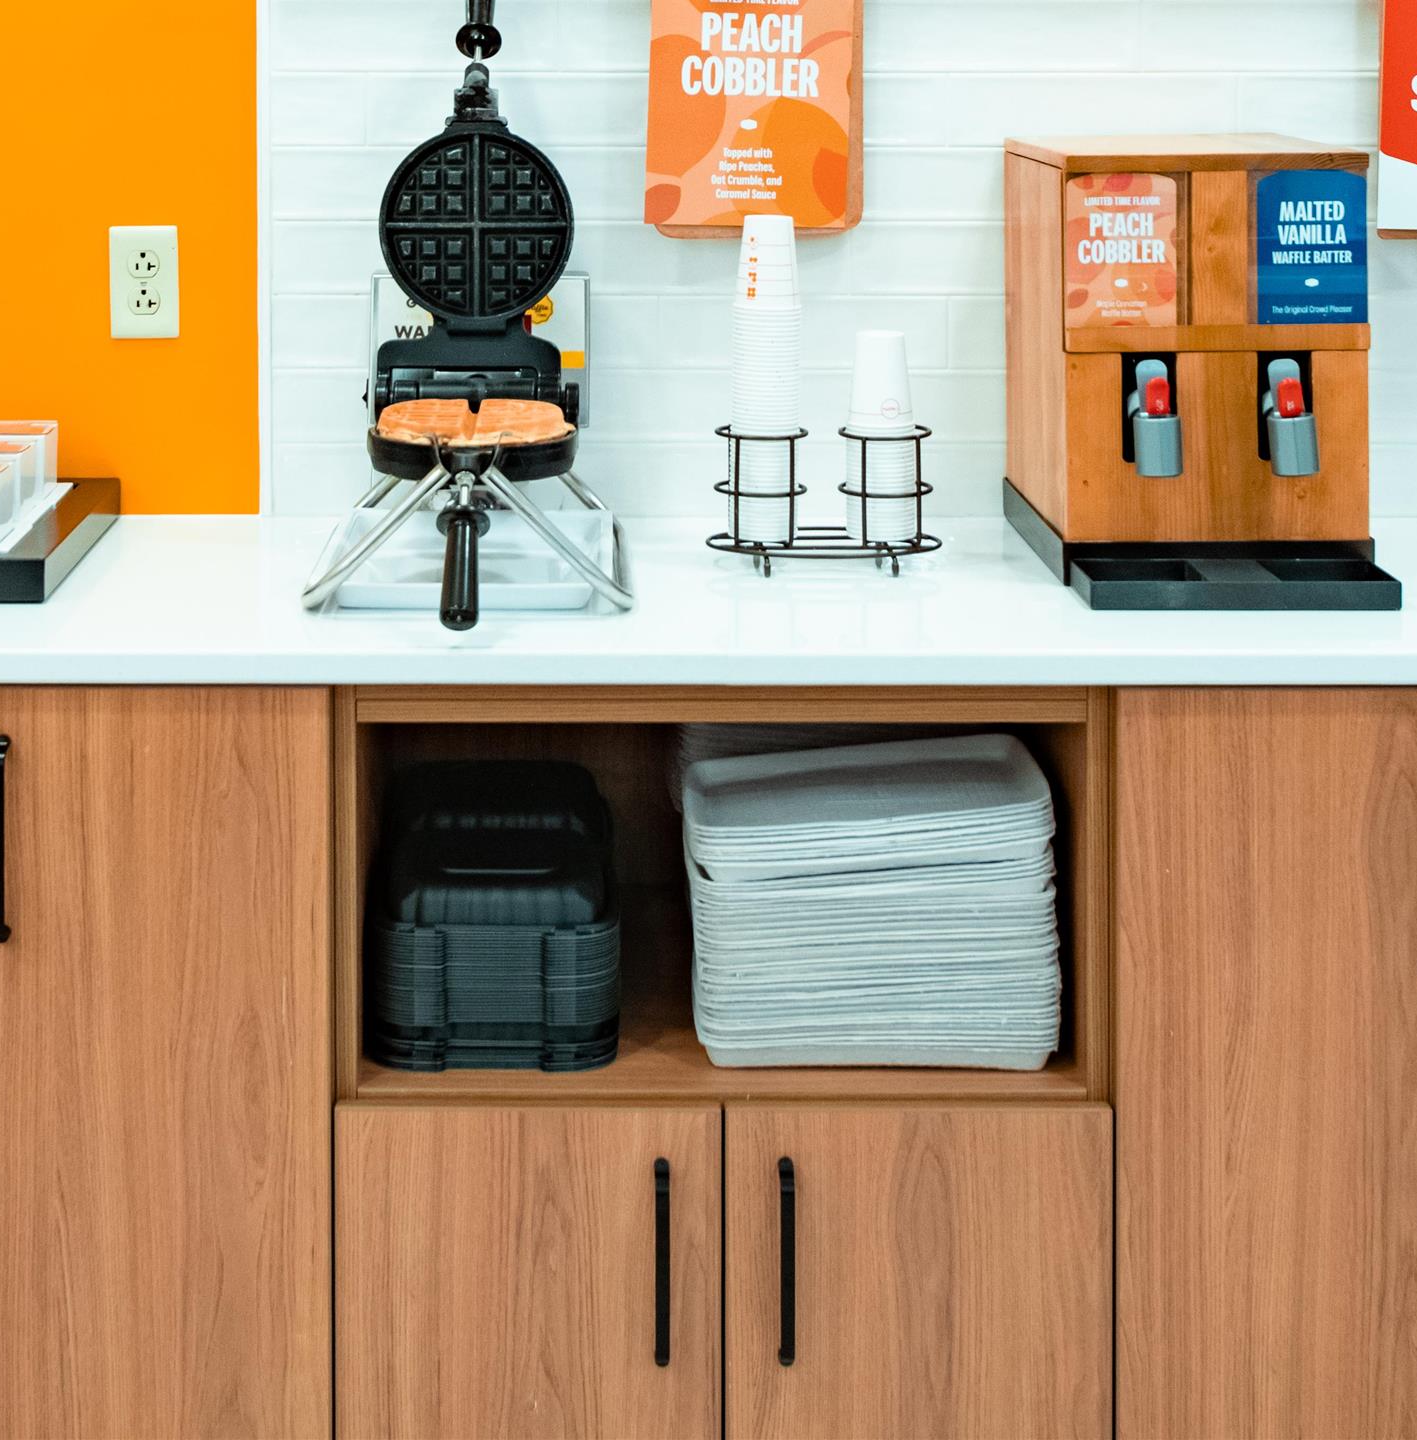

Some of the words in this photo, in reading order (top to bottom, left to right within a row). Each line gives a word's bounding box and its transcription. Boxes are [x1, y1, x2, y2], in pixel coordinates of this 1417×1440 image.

[700, 12, 803, 53] PEACH
[681, 55, 820, 98] COBBLER
[723, 147, 753, 160] Topped
[753, 148, 773, 159] with
[719, 160, 737, 173] Ripe
[738, 161, 775, 173] Peaches,
[711, 174, 726, 185] Oat
[727, 174, 765, 187] Crumble,
[766, 175, 783, 186] and
[715, 188, 751, 199] Caramel
[751, 189, 777, 200] Sauce
[1279, 200, 1345, 222] MALTED
[1089, 212, 1154, 237] PEACH
[1277, 224, 1347, 245] VANILLA
[1077, 239, 1166, 265] COBBLER
[1272, 250, 1312, 265] WAFFLE
[1313, 250, 1353, 264] BATTER
[1272, 305, 1284, 314] The
[1284, 305, 1308, 316] Original
[1309, 305, 1329, 314] Crowd
